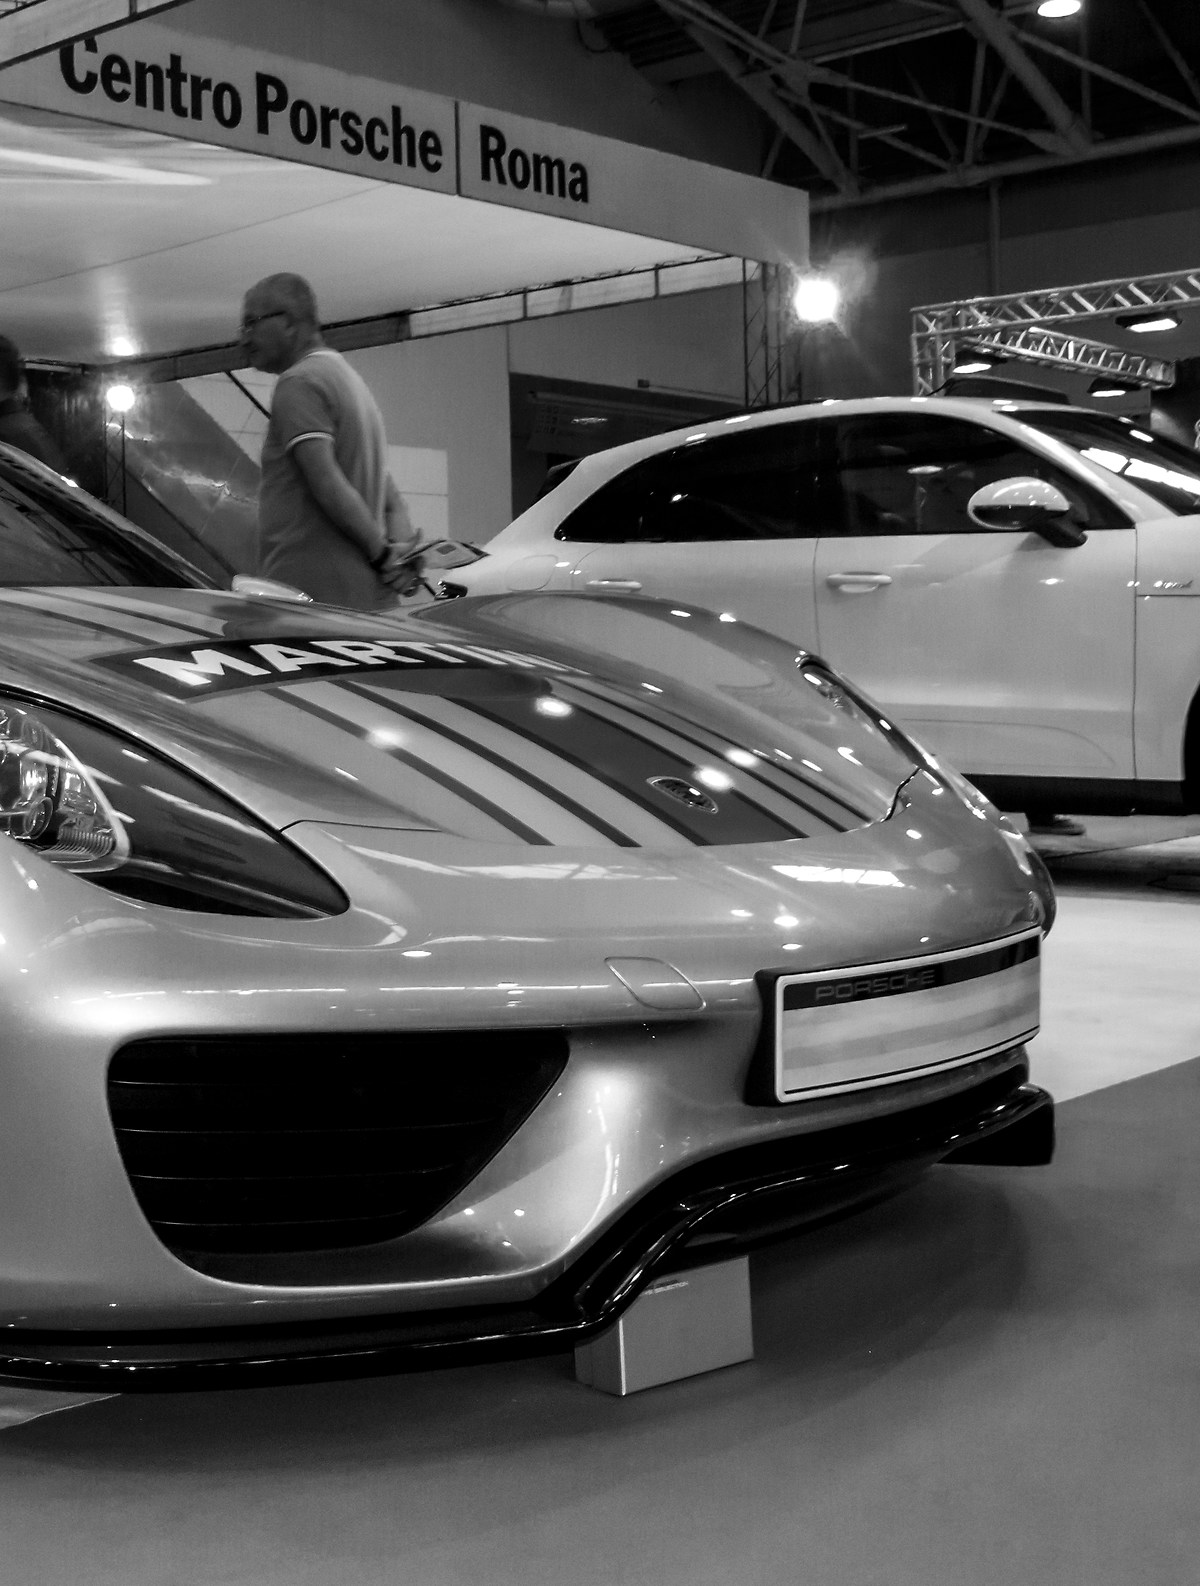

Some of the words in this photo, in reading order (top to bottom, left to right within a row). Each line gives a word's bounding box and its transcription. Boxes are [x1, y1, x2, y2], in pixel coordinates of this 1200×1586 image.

[59, 36, 243, 129] Centro
[255, 71, 443, 173] Porsche
[479, 124, 589, 204] Roma
[132, 640, 591, 687] MARTINI
[814, 969, 936, 1001] PORSCHE
